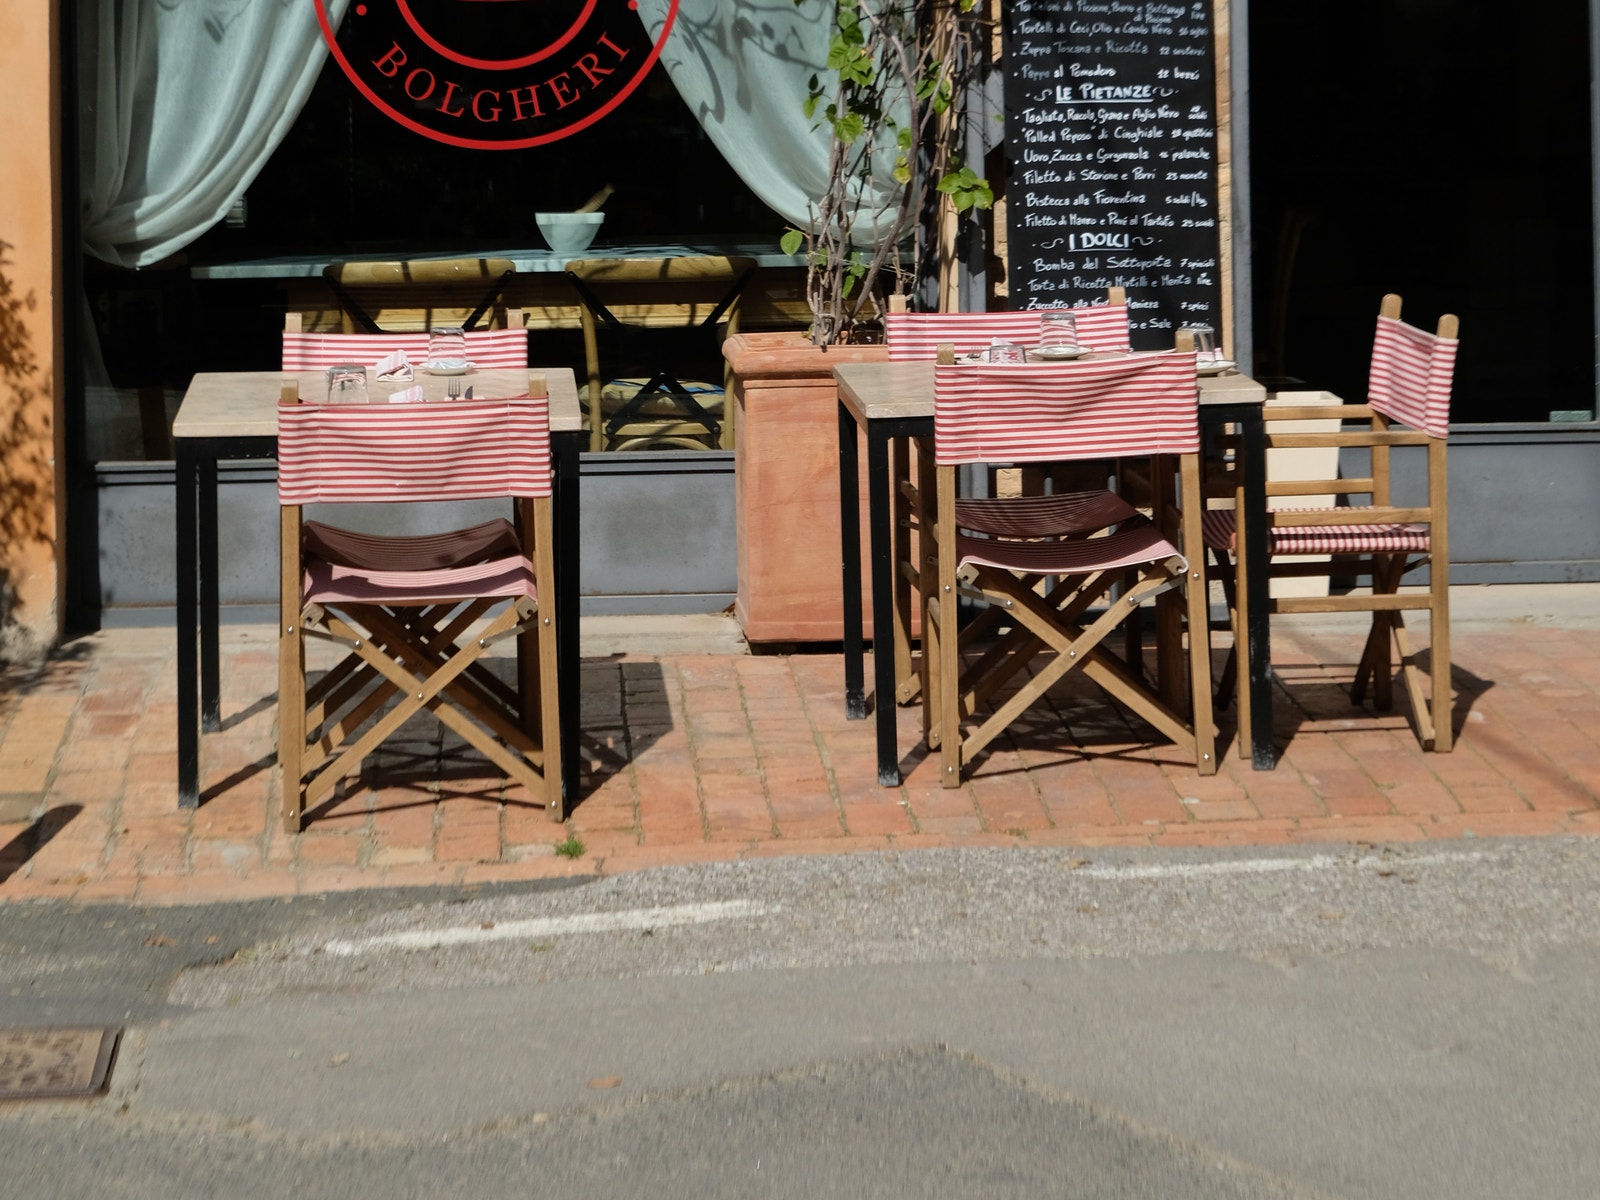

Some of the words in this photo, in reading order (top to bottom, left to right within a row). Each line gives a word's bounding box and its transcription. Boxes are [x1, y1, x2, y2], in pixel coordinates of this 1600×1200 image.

[1019, 40, 1052, 58] Zuppa
[1104, 39, 1149, 55] Ricotta
[371, 31, 630, 123] BOLGHERI
[1053, 63, 1064, 79] al
[1069, 62, 1118, 78] Pomodoro
[1056, 84, 1072, 101] LE
[1078, 82, 1153, 100] PIETANZE
[1113, 125, 1164, 143] Cinghiale
[1051, 148, 1083, 162] Zucca
[1096, 146, 1150, 164] Gorgonzola
[1022, 168, 1062, 185] Filetto
[1064, 169, 1076, 183] di
[1079, 168, 1119, 182] Storione
[1131, 165, 1157, 182] Porri
[1025, 191, 1071, 208] Bistecca
[1073, 193, 1090, 206] alla
[1092, 188, 1147, 206] Fiorentina
[1024, 212, 1058, 228] Filetto
[1058, 214, 1068, 227] di
[1069, 212, 1097, 227] Manzo
[1080, 232, 1130, 249] DOLCI
[1032, 257, 1076, 273] Bomba
[1081, 256, 1099, 270] del
[1106, 254, 1173, 272] Sottoporta
[1027, 278, 1057, 292] Torta
[1058, 277, 1070, 290] di
[1161, 274, 1192, 286] Menta
[1026, 297, 1069, 311] Zuccotto
[1073, 299, 1089, 309] alla
[1148, 318, 1173, 330] Sale
